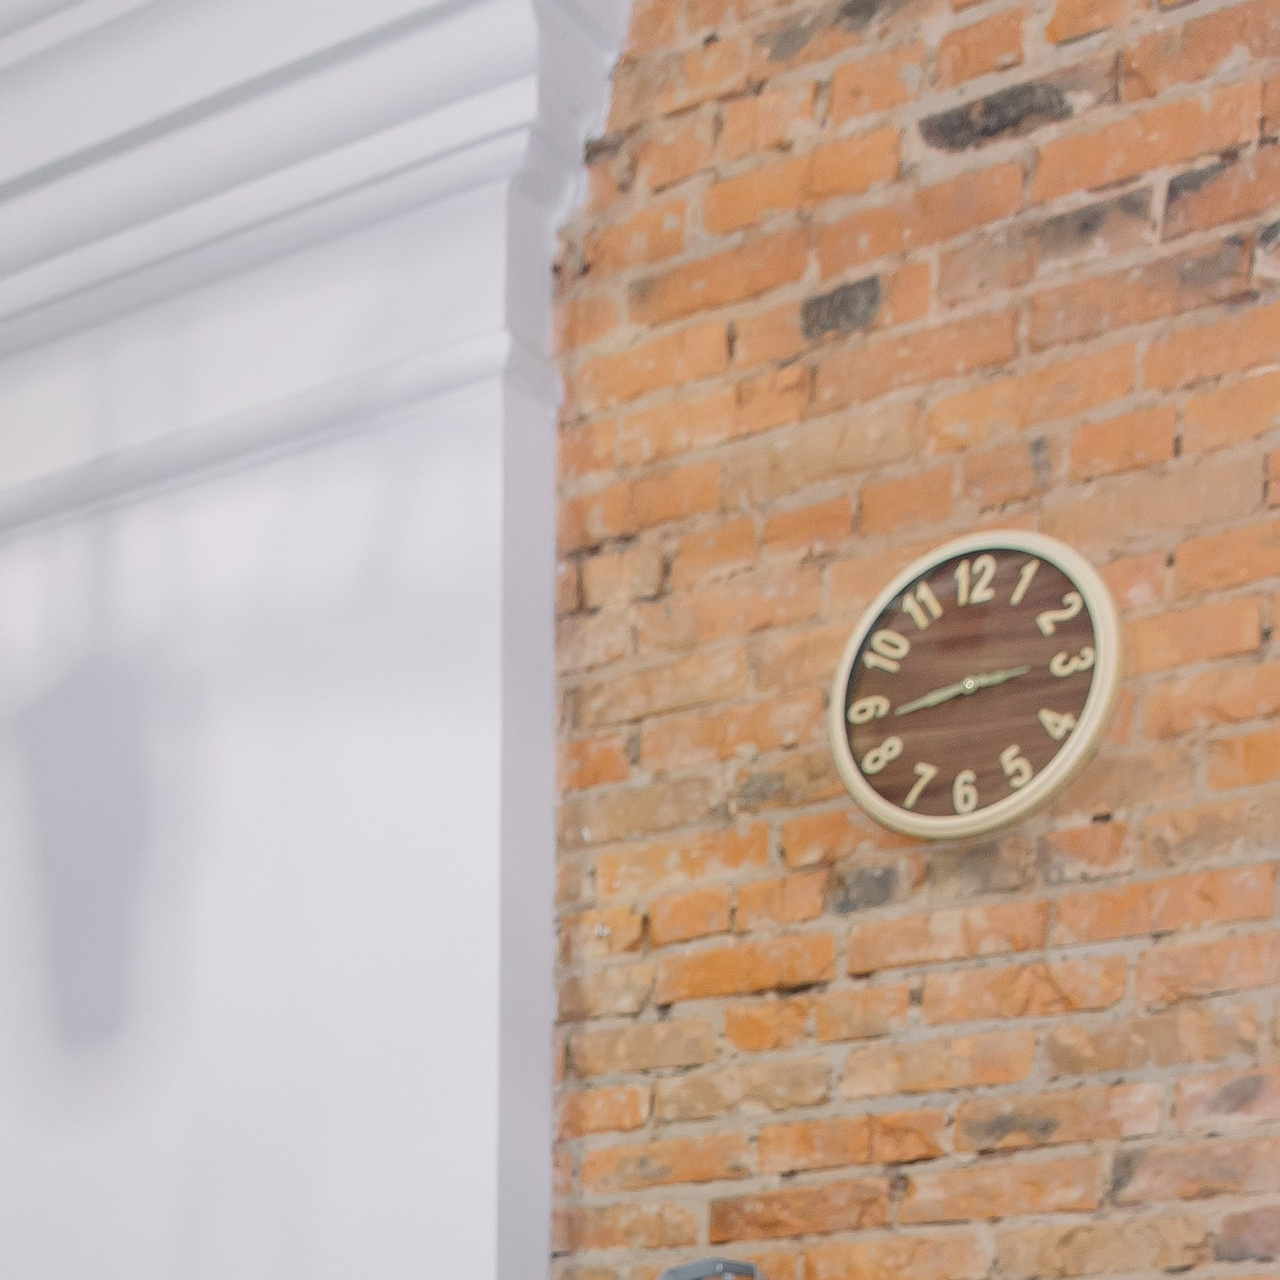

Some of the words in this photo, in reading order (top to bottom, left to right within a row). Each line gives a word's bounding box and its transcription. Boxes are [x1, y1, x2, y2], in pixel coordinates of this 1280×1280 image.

[954, 554, 997, 607] 12
[1009, 559, 1040, 606] 1
[902, 581, 944, 630] 11
[1036, 591, 1083, 637] 2
[863, 629, 911, 673] 10
[1049, 647, 1095, 677] 3
[847, 695, 890, 725] 9
[1037, 708, 1076, 740] 4
[861, 736, 903, 775] 8
[1000, 744, 1033, 789] 5
[903, 761, 939, 809] 7
[953, 769, 978, 814] 6
